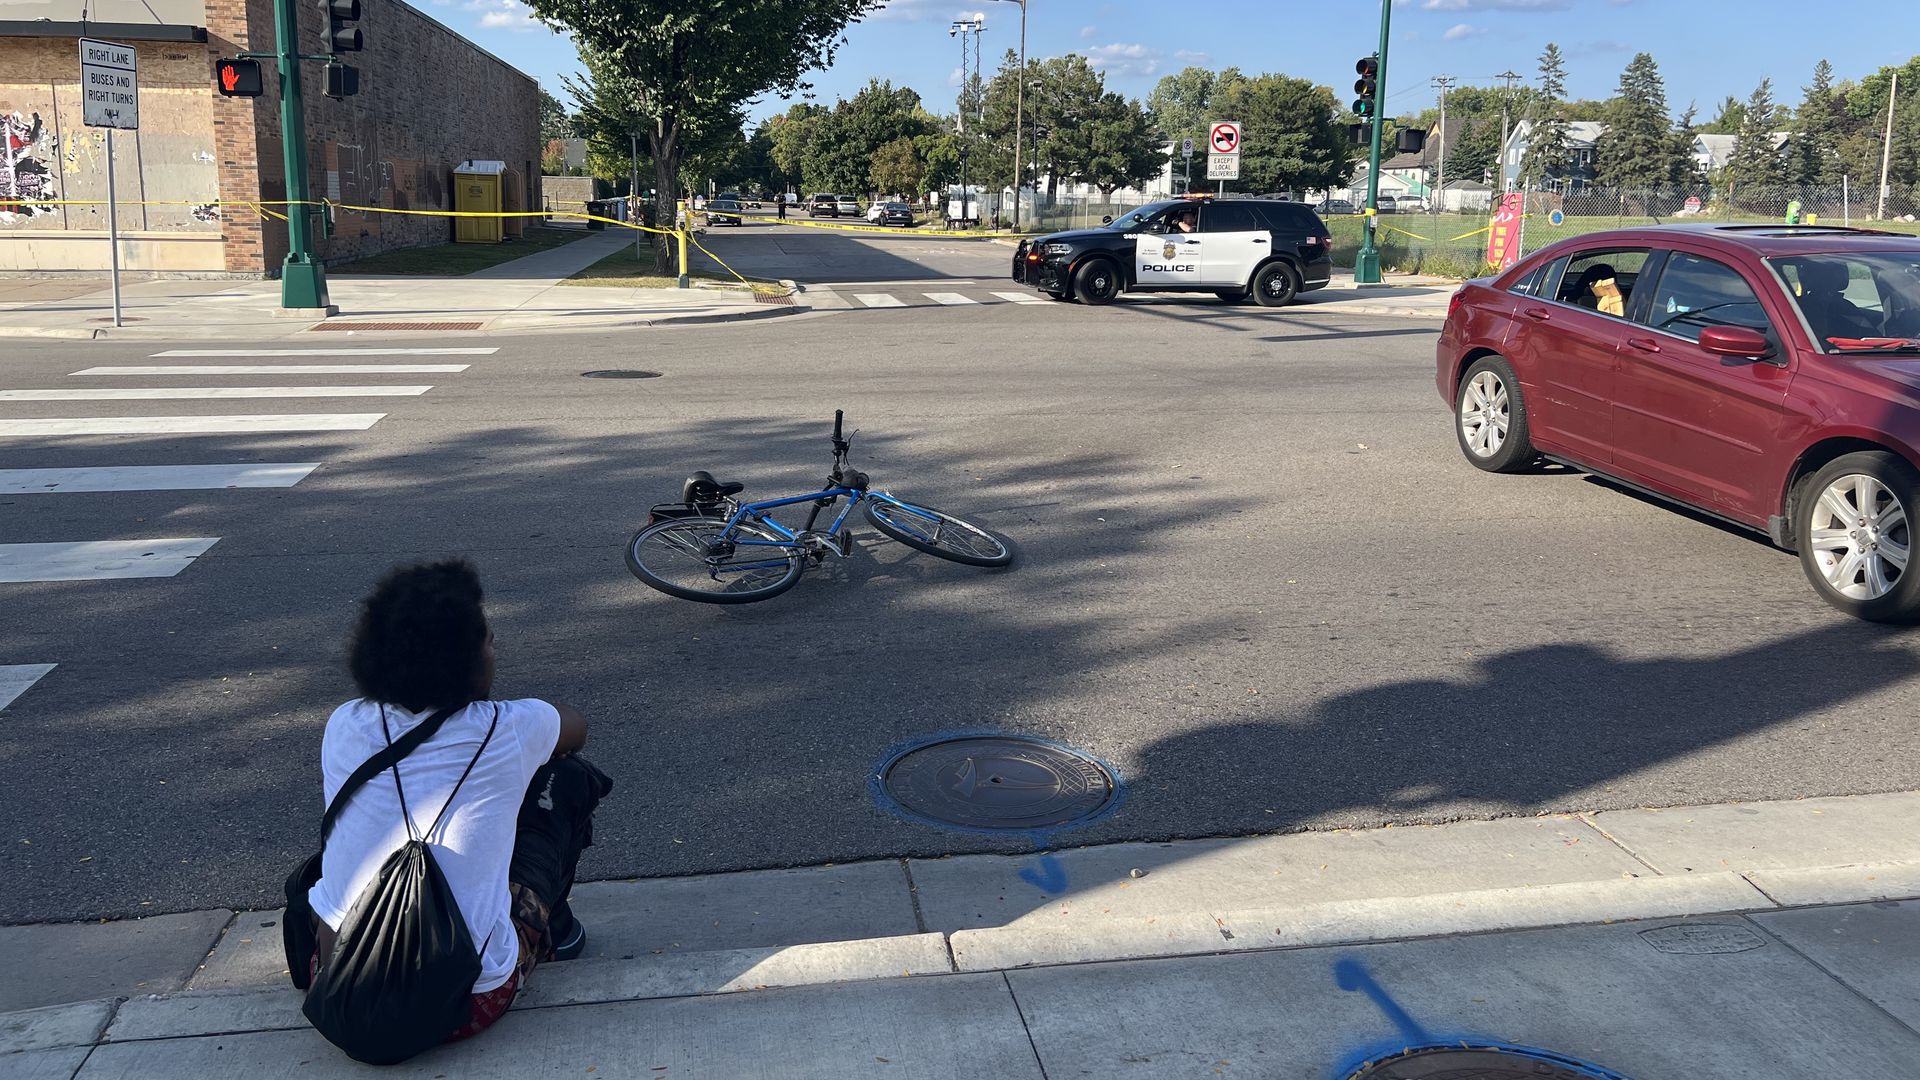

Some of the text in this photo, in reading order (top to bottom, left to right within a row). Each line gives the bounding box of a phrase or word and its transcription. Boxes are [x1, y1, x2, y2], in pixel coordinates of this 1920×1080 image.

[88, 48, 130, 65] RIGHT LANE
[90, 73, 130, 88] BUSES AND
[88, 89, 134, 105] RIGHT TURNS
[1142, 264, 1195, 272] POLICE
